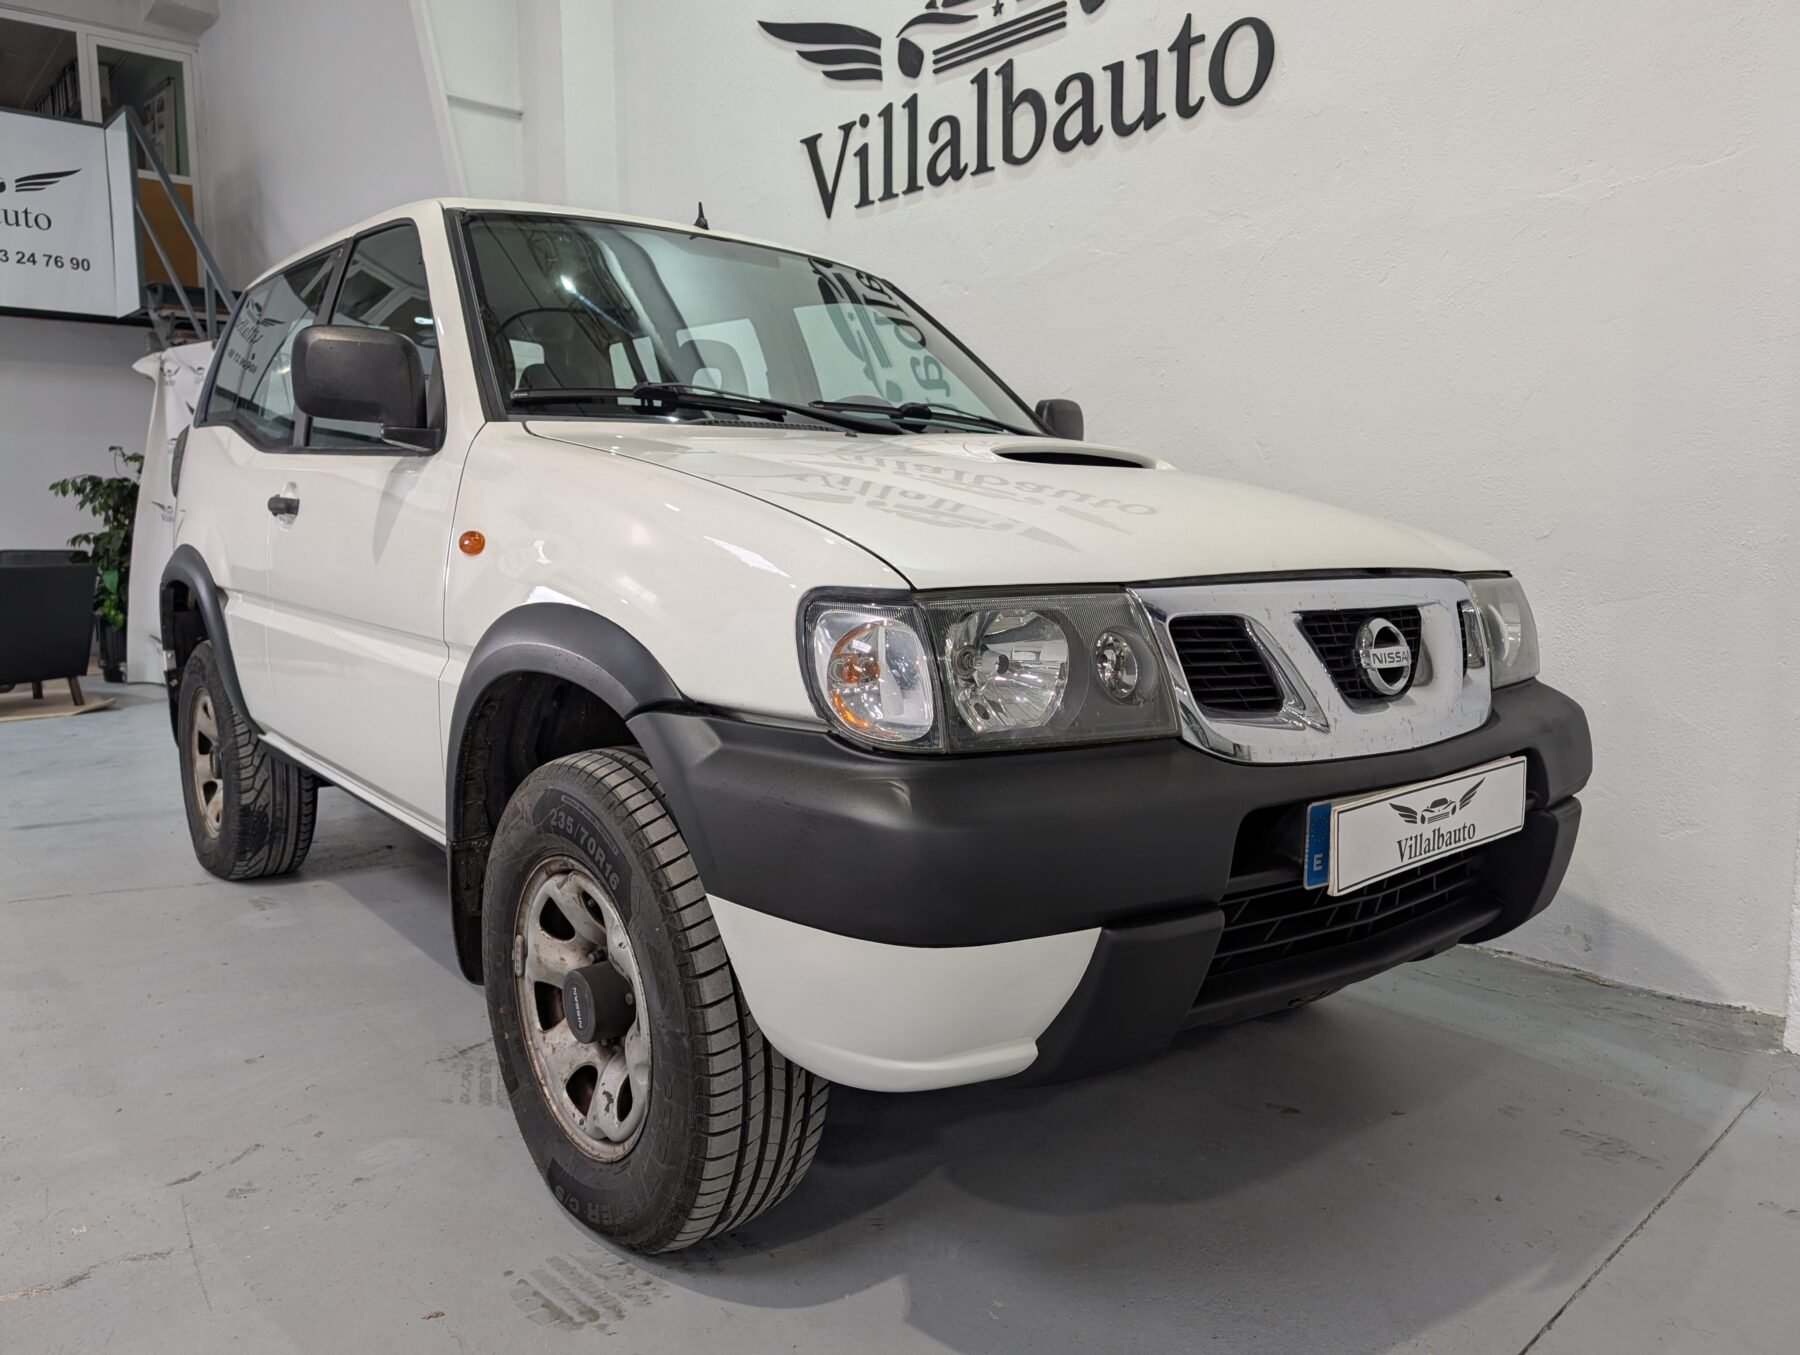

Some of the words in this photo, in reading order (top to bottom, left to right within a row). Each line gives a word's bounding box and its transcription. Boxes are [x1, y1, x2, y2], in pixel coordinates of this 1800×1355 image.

[800, 13, 1275, 219] Villalbauto
[0, 206, 52, 231] uto
[15, 251, 37, 266] 24
[42, 253, 65, 269] 76
[70, 257, 91, 272] 90
[550, 808, 620, 891] 235/70R16
[1397, 822, 1476, 863] Villalbauto
[1313, 853, 1323, 871] E
